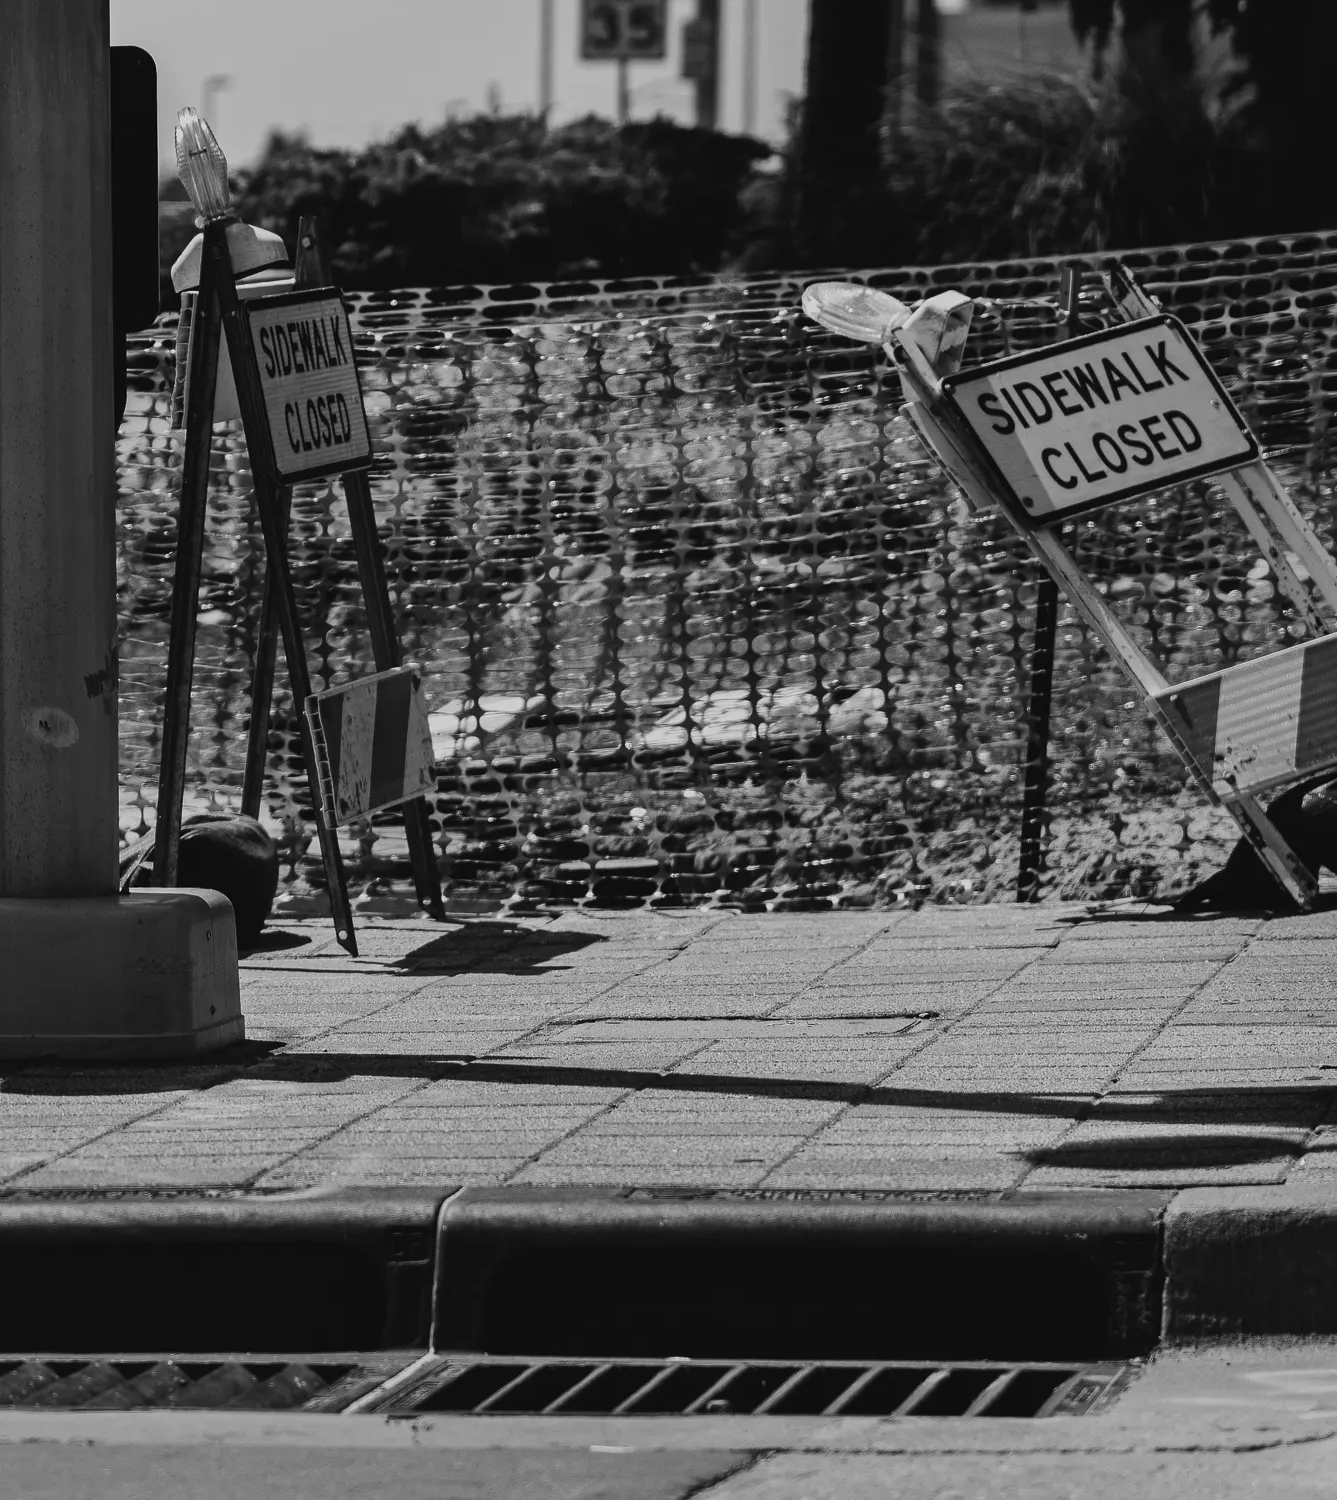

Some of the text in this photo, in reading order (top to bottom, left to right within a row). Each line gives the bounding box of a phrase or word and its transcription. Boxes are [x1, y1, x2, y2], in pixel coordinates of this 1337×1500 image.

[259, 314, 348, 379] SIDEWALK
[284, 392, 352, 454] CLOSED
[976, 340, 1190, 436] SIDEWALK
[1041, 409, 1202, 489] CLOSED
